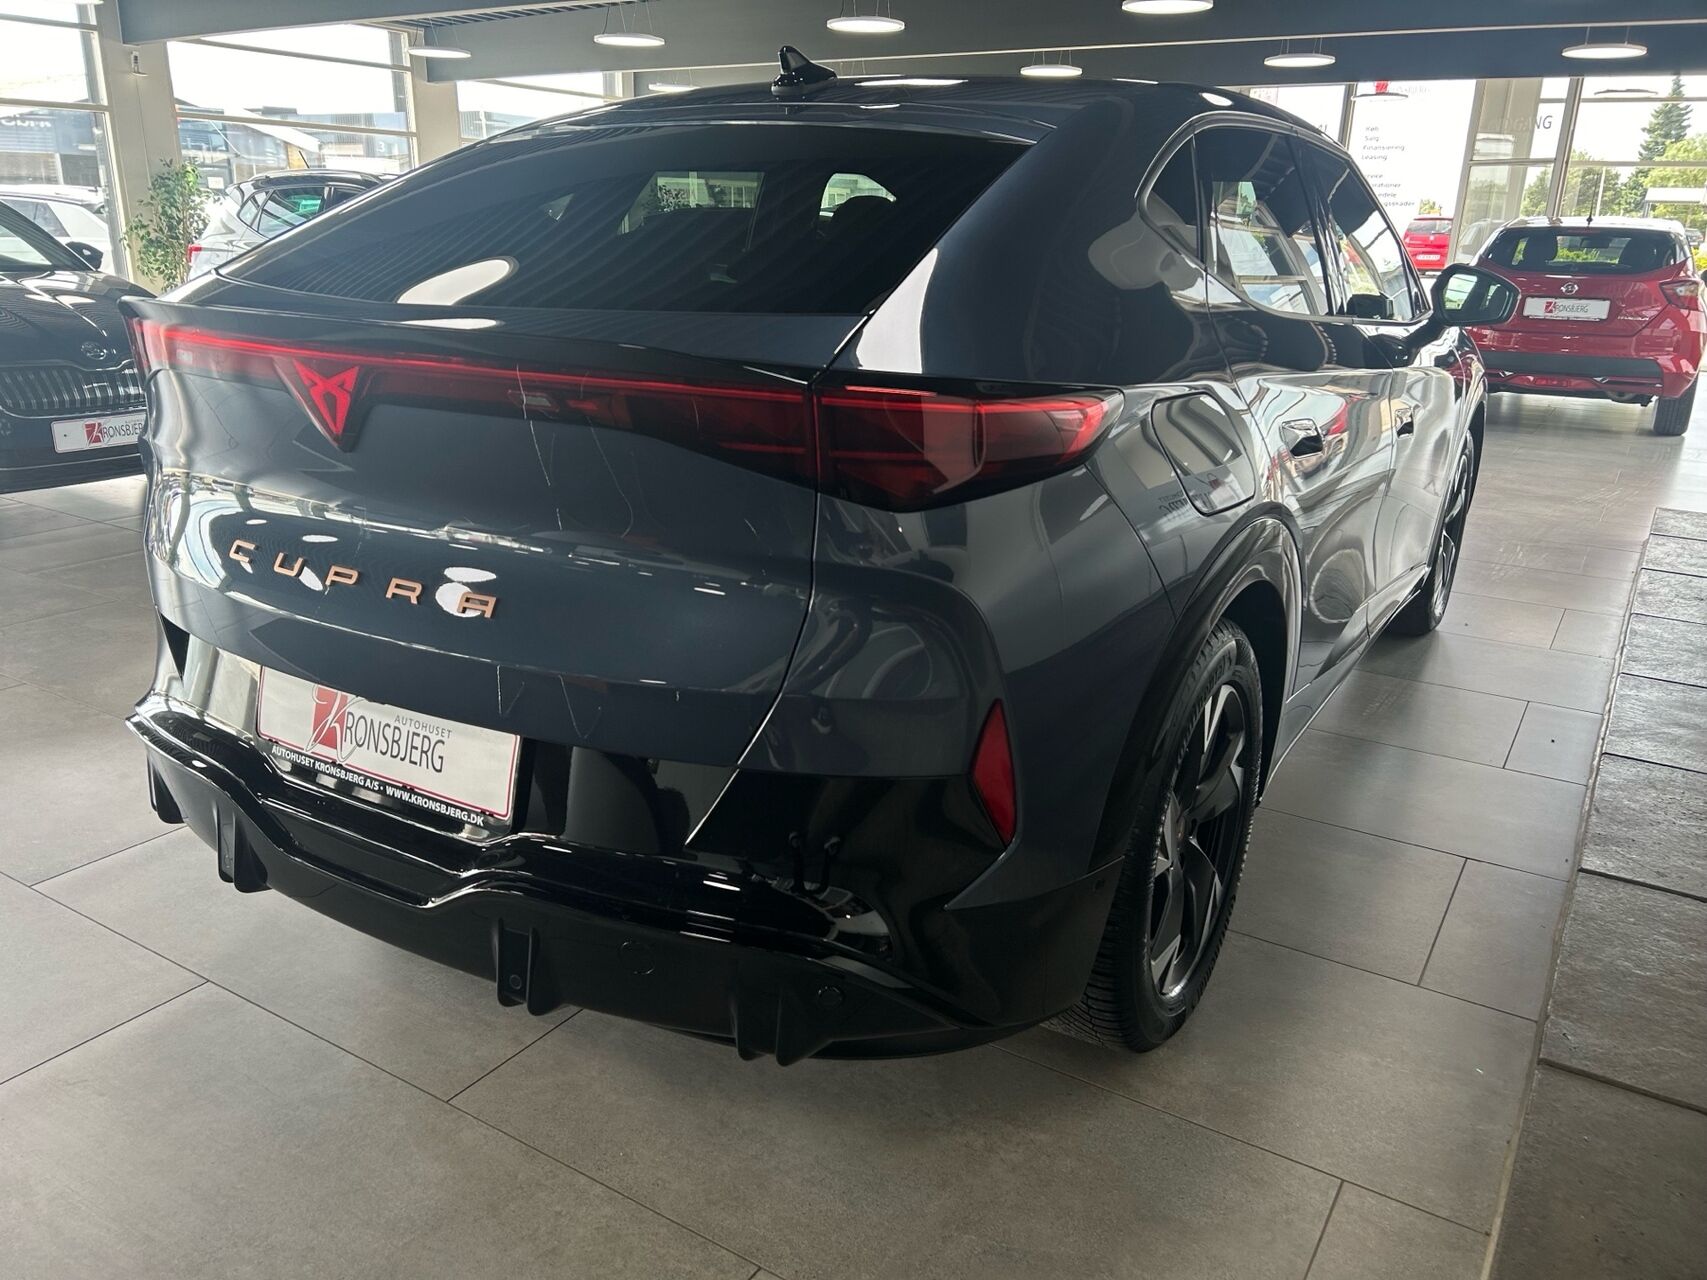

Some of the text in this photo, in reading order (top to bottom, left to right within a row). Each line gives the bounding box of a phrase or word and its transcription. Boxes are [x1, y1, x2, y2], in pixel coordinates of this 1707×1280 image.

[228, 538, 497, 619] CUPRA
[394, 713, 452, 740] AUTOHUSET
[271, 744, 485, 827] AUTOHUSET KRONSBJERG A/S WWW.KRONSBJERG.DK
